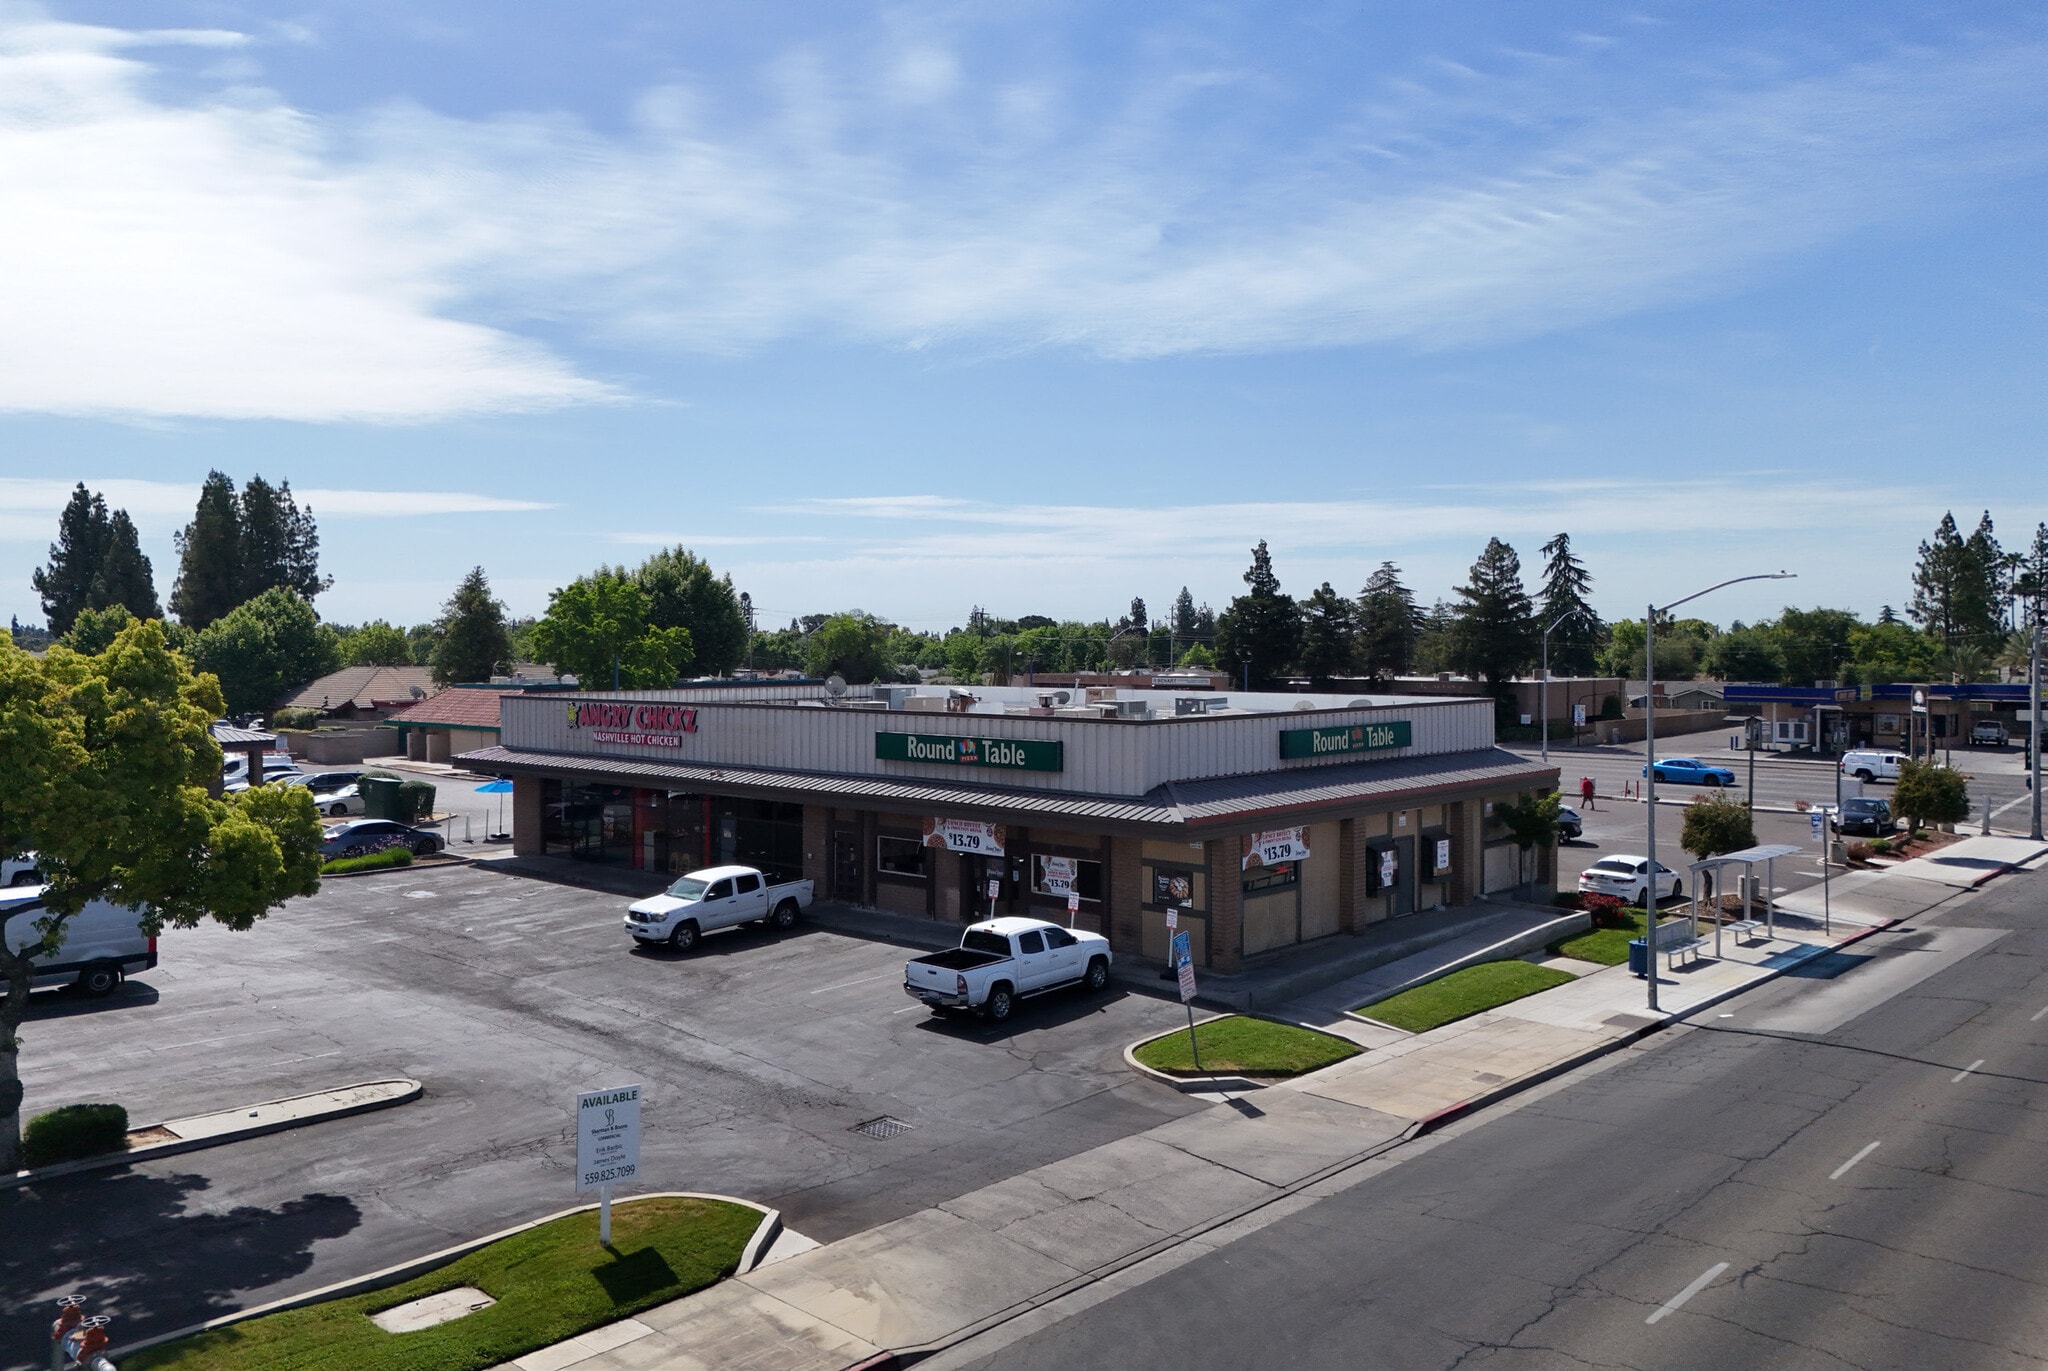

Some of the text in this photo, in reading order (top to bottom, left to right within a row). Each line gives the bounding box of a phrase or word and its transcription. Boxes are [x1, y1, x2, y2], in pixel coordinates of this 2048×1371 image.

[578, 703, 698, 733] ANGRY CHICKZ
[593, 731, 679, 747] NASHVILLE HOT CHICKEN
[1313, 727, 1394, 752] Round Table
[907, 736, 1025, 765] Round Table
[948, 832, 980, 849] $13.79
[1263, 843, 1291, 861] $13.79
[582, 1090, 637, 1109] AVAILABLE
[584, 1164, 636, 1185] 559.825.7099
